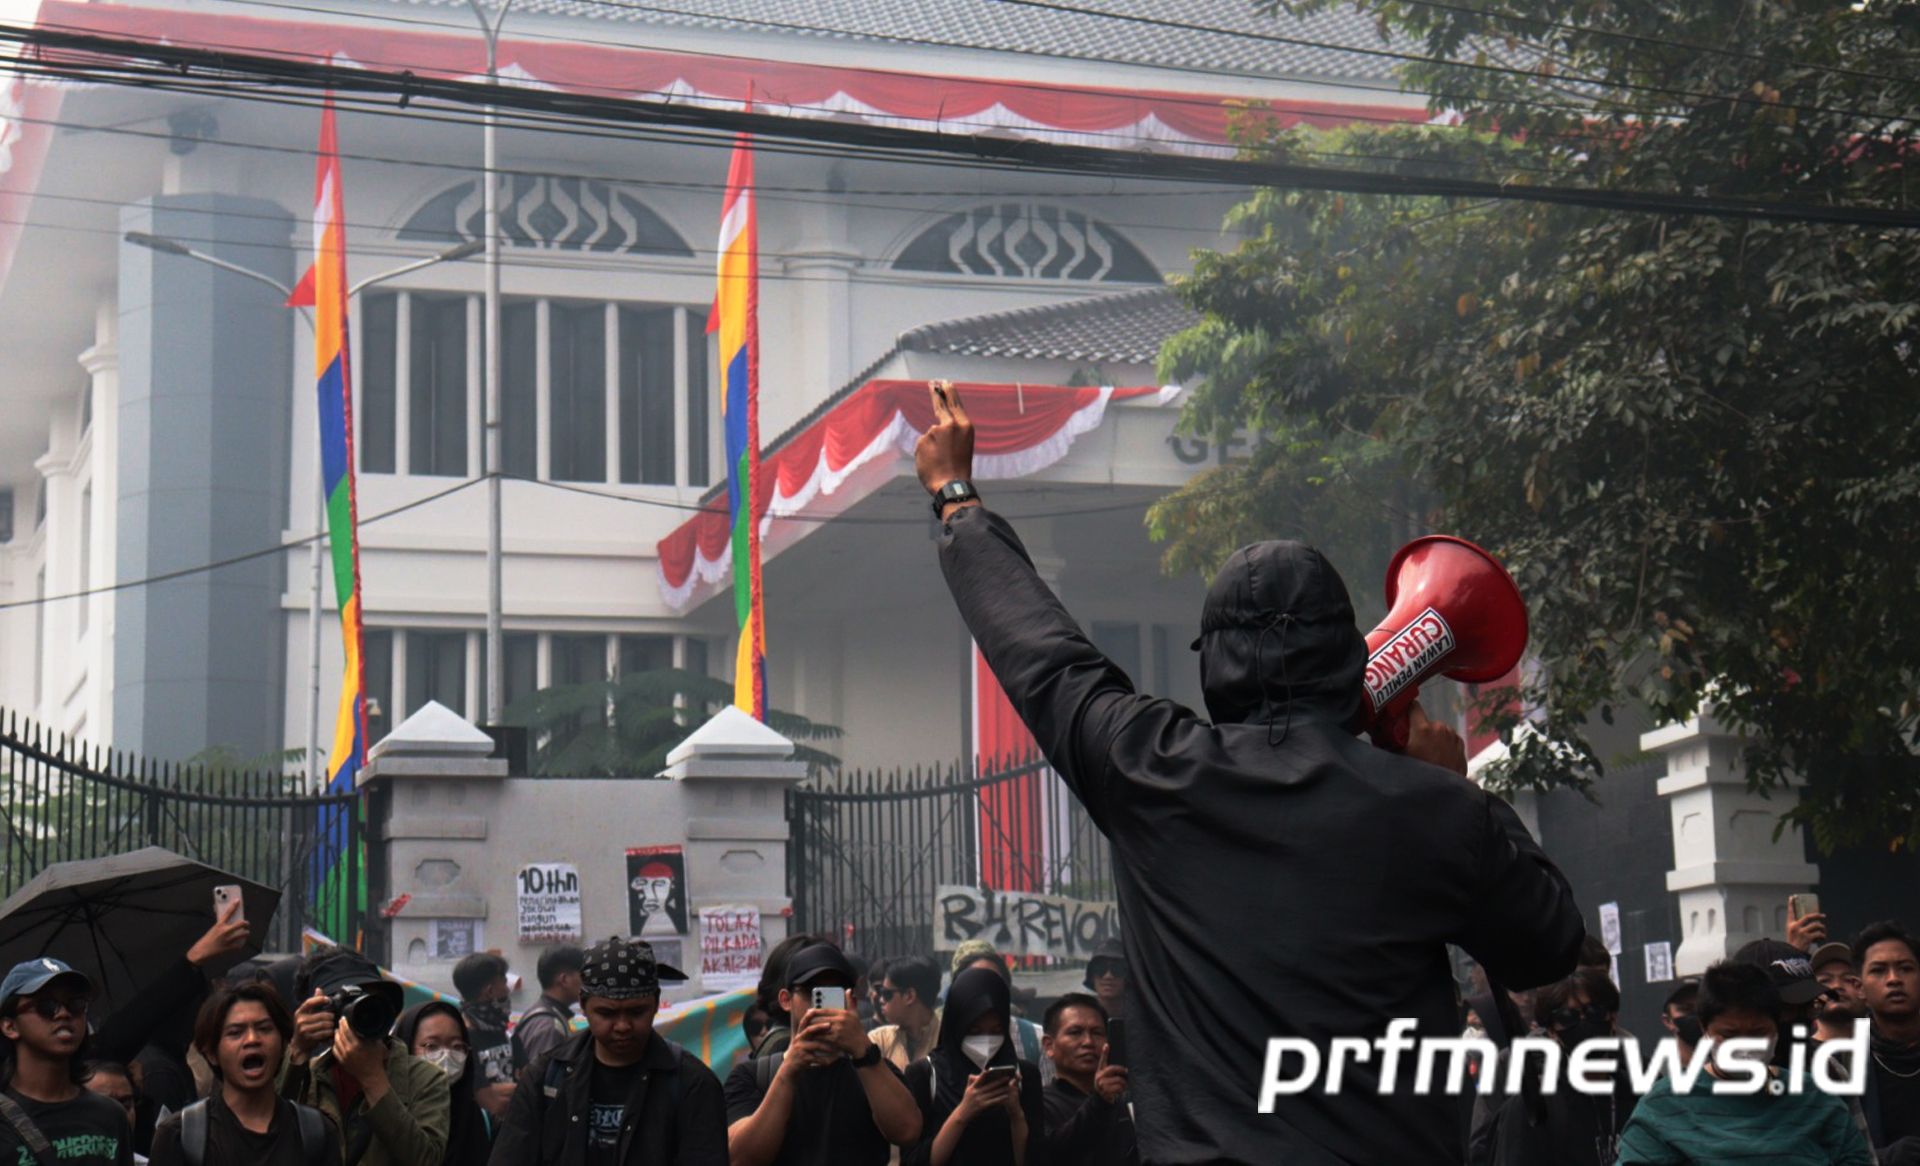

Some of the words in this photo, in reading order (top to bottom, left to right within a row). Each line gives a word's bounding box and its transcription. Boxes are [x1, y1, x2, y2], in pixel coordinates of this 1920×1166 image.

[1365, 617, 1443, 691] CURANG
[1413, 635, 1450, 670] LAWAN
[1376, 668, 1413, 703] PEMILU
[704, 912, 758, 933] TOLAK
[704, 933, 759, 954] PILKADA
